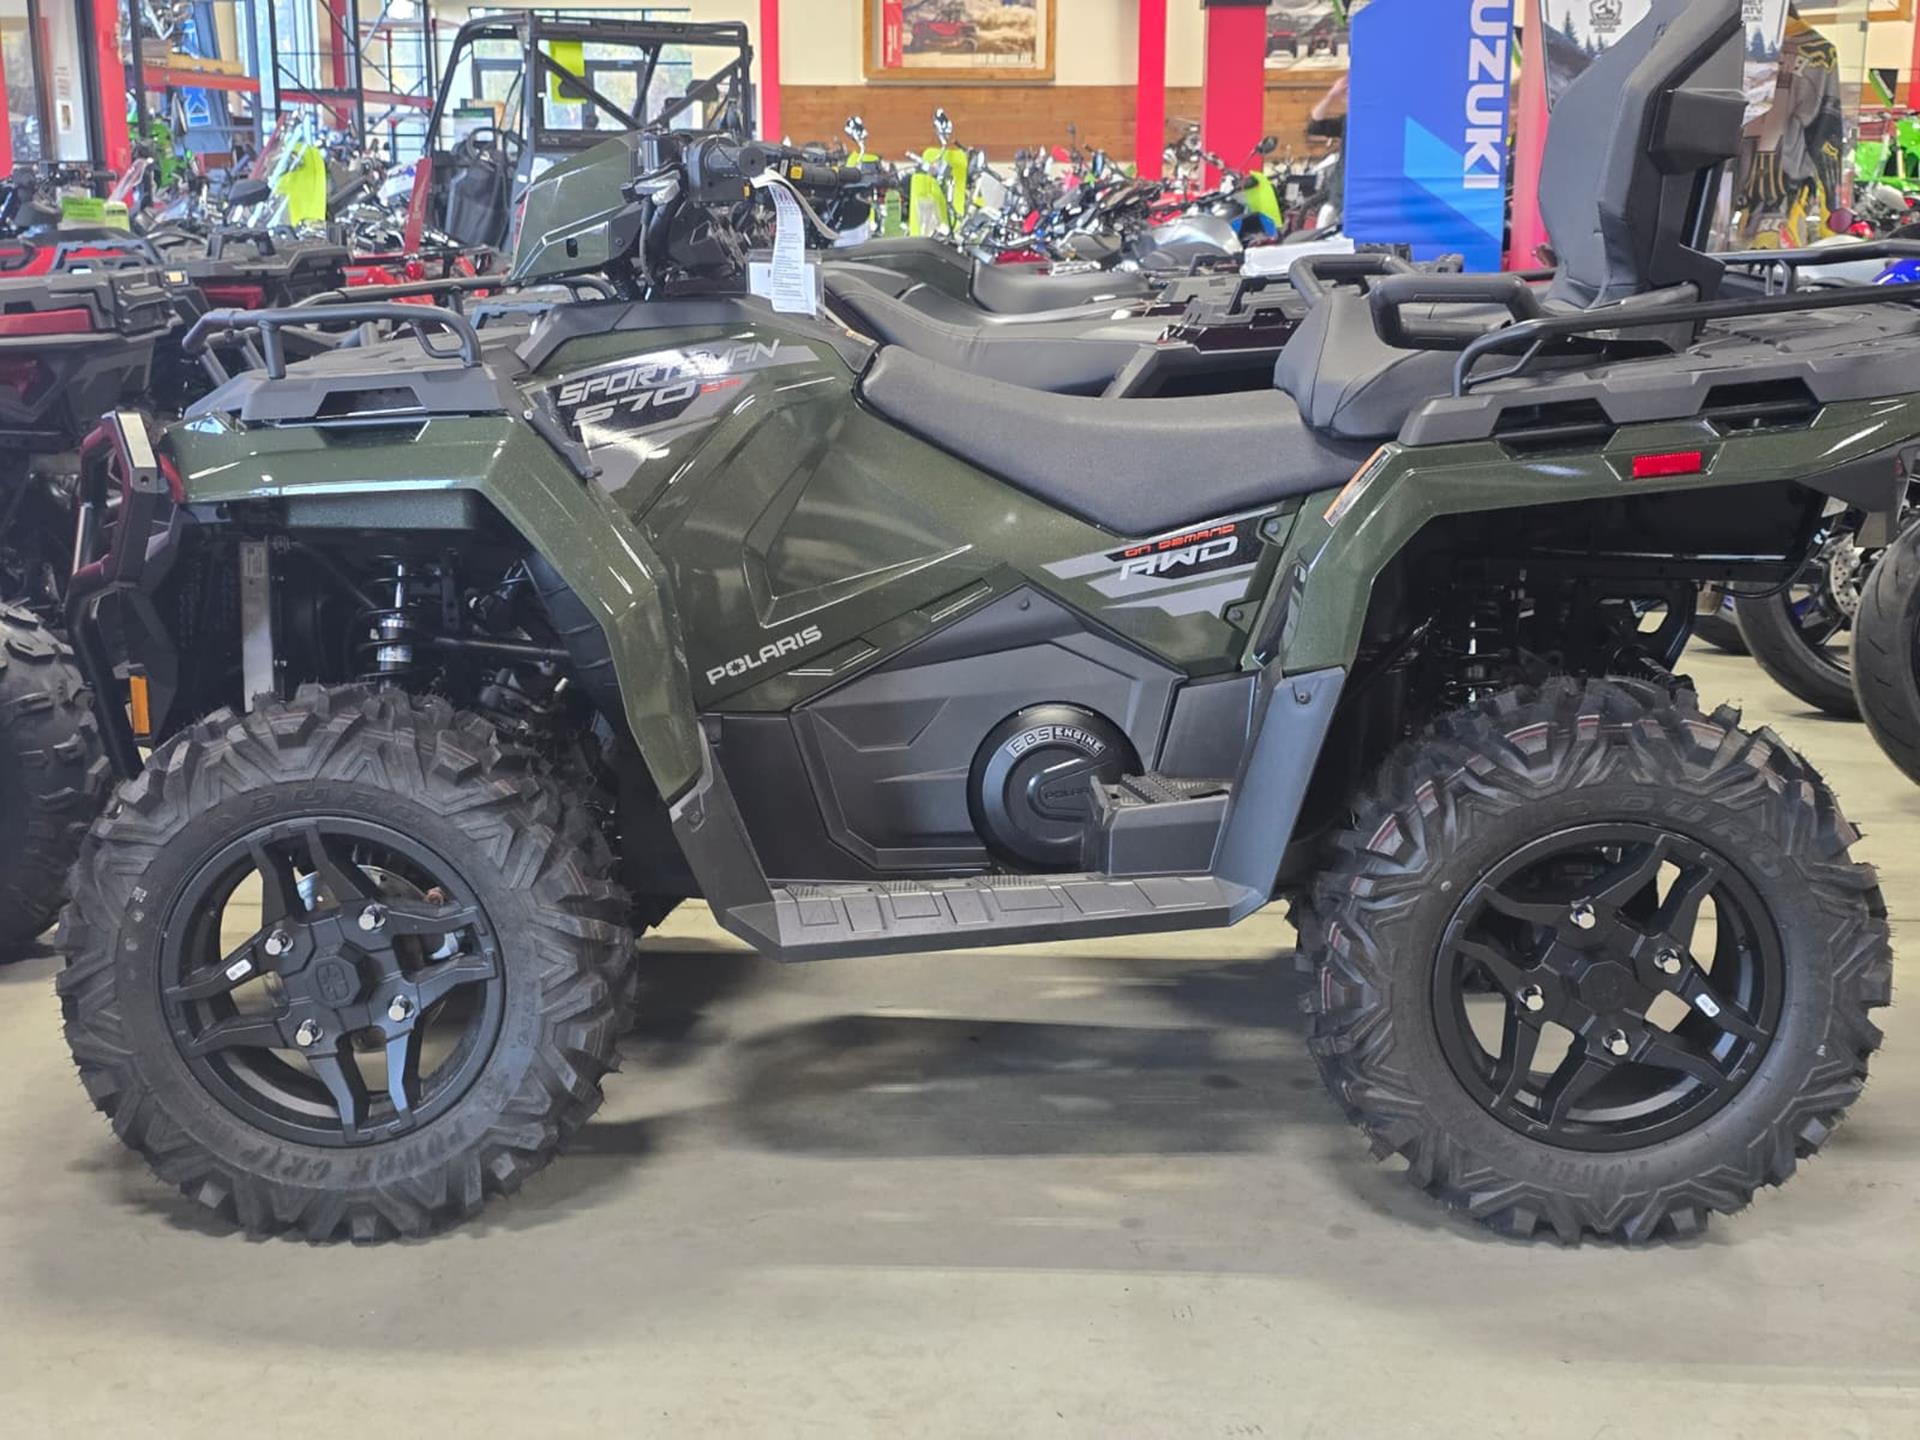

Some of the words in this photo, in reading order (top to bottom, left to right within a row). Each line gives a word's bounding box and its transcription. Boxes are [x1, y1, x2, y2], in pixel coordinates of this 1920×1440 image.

[1463, 0, 1509, 189] UZUKI
[557, 338, 781, 407] SPORTMAN
[571, 378, 698, 428] 570
[1120, 535, 1239, 580] AWD
[1124, 544, 1153, 558] ON
[1157, 523, 1236, 550] DEMAND
[705, 624, 823, 686] POLARIS
[1010, 728, 1050, 755] EBS
[1054, 726, 1103, 753] ENGINE
[1043, 786, 1094, 800] POLAR
